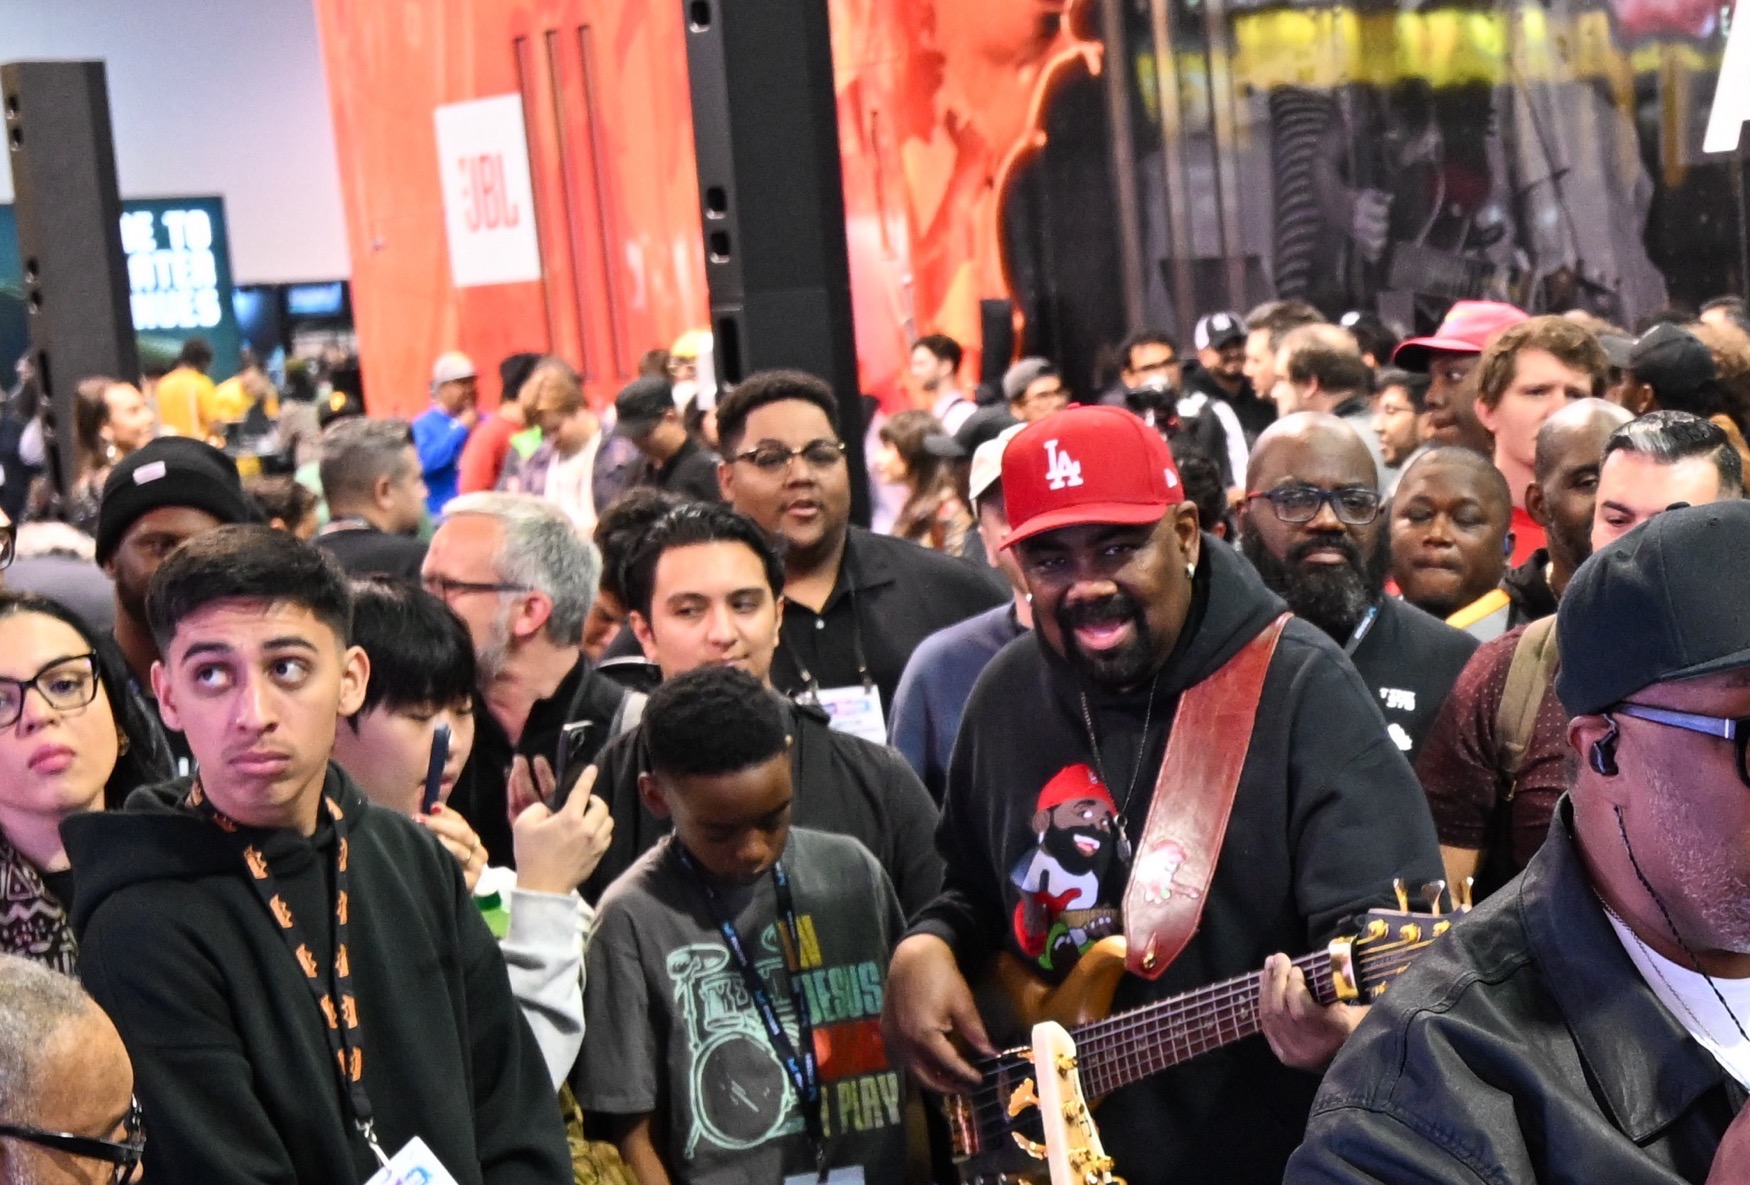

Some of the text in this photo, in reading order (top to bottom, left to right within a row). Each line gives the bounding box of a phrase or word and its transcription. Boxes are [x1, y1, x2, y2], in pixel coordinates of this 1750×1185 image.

[465, 153, 520, 232] JBL
[161, 208, 212, 251] TO
[1043, 439, 1084, 490] LA
[802, 960, 887, 1027] JESUS
[836, 1072, 901, 1135] PLAY
